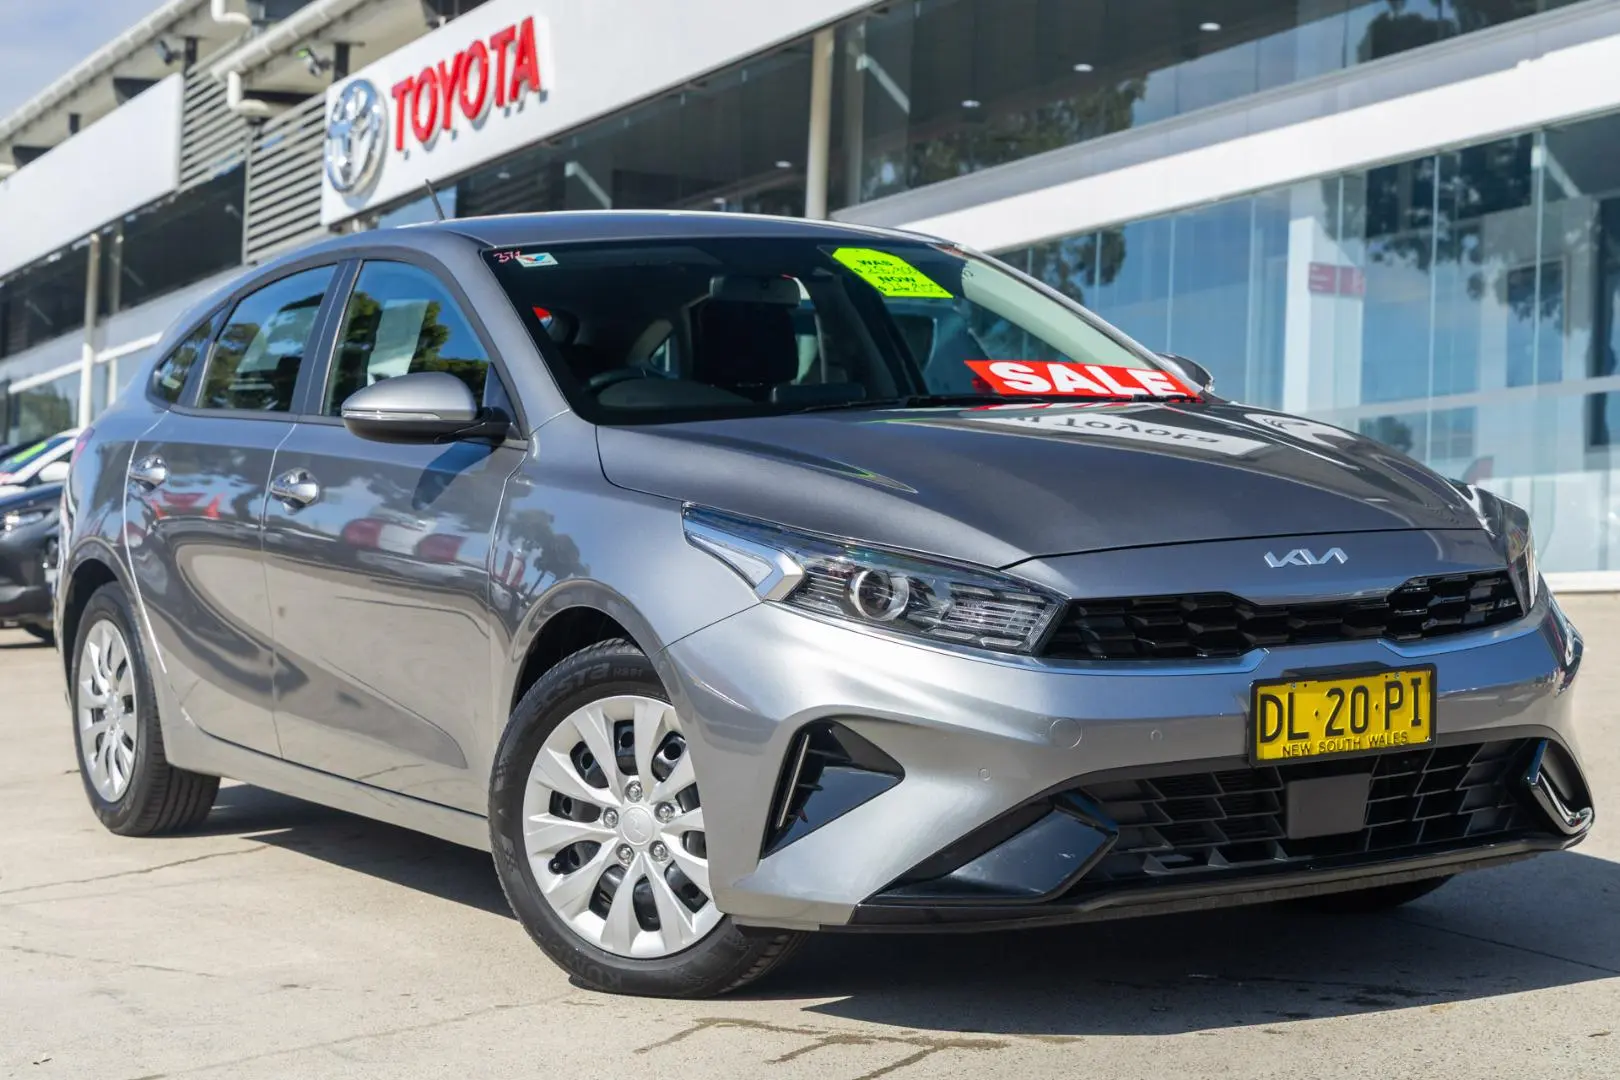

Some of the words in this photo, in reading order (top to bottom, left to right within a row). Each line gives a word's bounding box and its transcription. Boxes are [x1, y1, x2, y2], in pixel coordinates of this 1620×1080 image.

[391, 15, 541, 152] TOYOTA
[877, 275, 917, 284] NOW
[989, 361, 1181, 398] SALE
[1263, 546, 1349, 568] KIA
[1282, 743, 1312, 757] NEW
[1319, 738, 1361, 753] SOUTH
[1368, 731, 1408, 746] WALES
